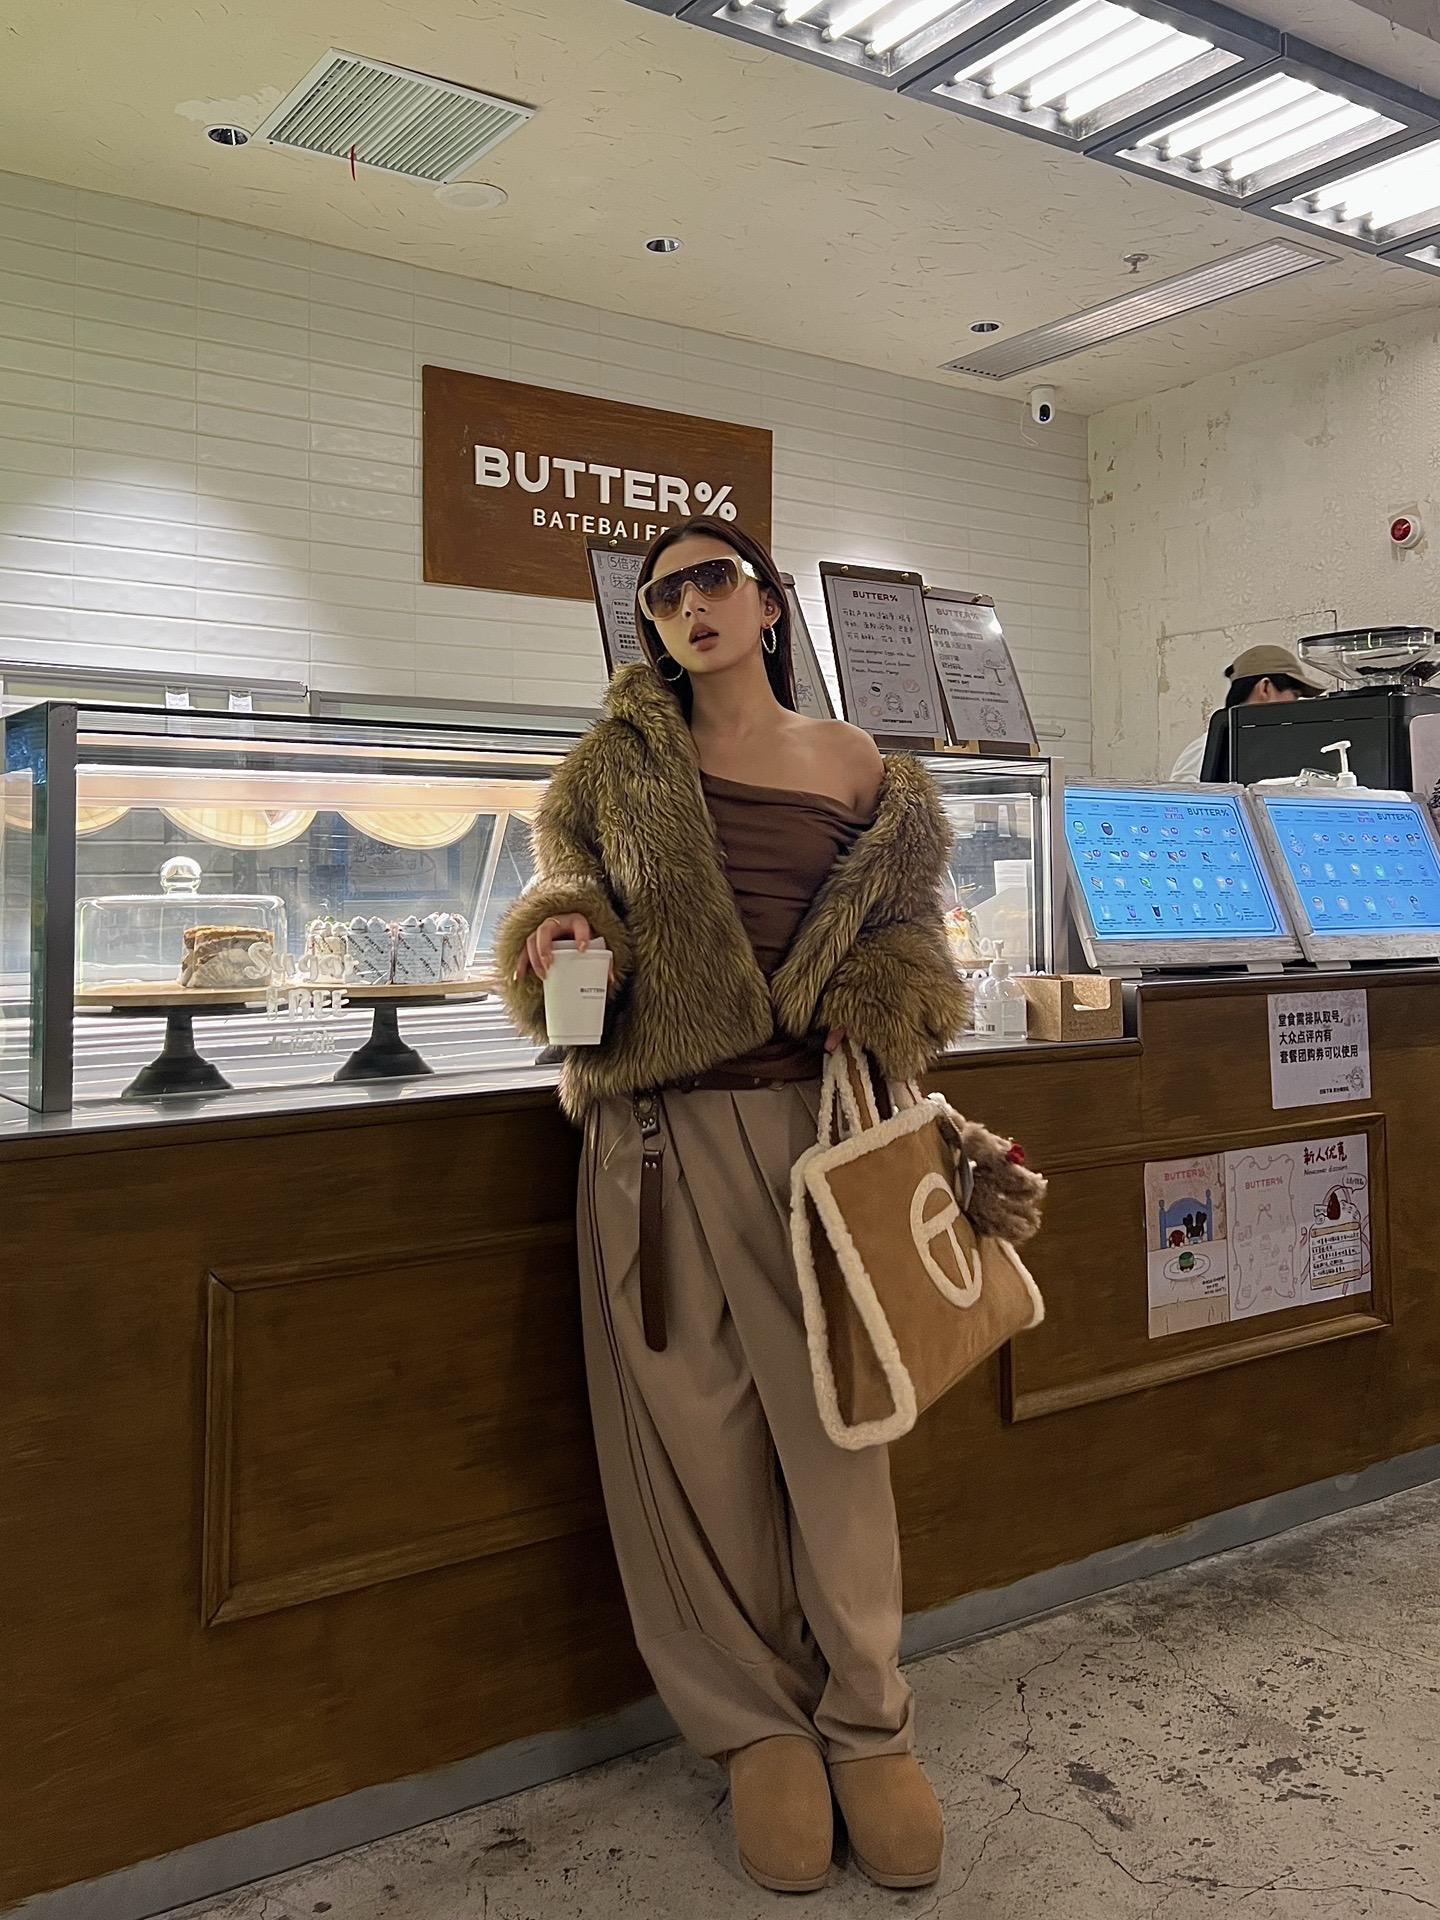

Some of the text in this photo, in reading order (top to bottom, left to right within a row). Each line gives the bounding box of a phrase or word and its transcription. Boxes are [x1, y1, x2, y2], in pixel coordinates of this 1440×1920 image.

[474, 444, 738, 522] BUTTER%
[852, 590, 898, 602] BUTTER%
[1186, 807, 1230, 817] BUTTER%
[1279, 1028, 1333, 1046] 大众点评内有
[1280, 1044, 1359, 1064] 套餐团购券可以使用
[1303, 1141, 1348, 1166] 新人优惠
[1244, 1176, 1283, 1190] BUTTER%
